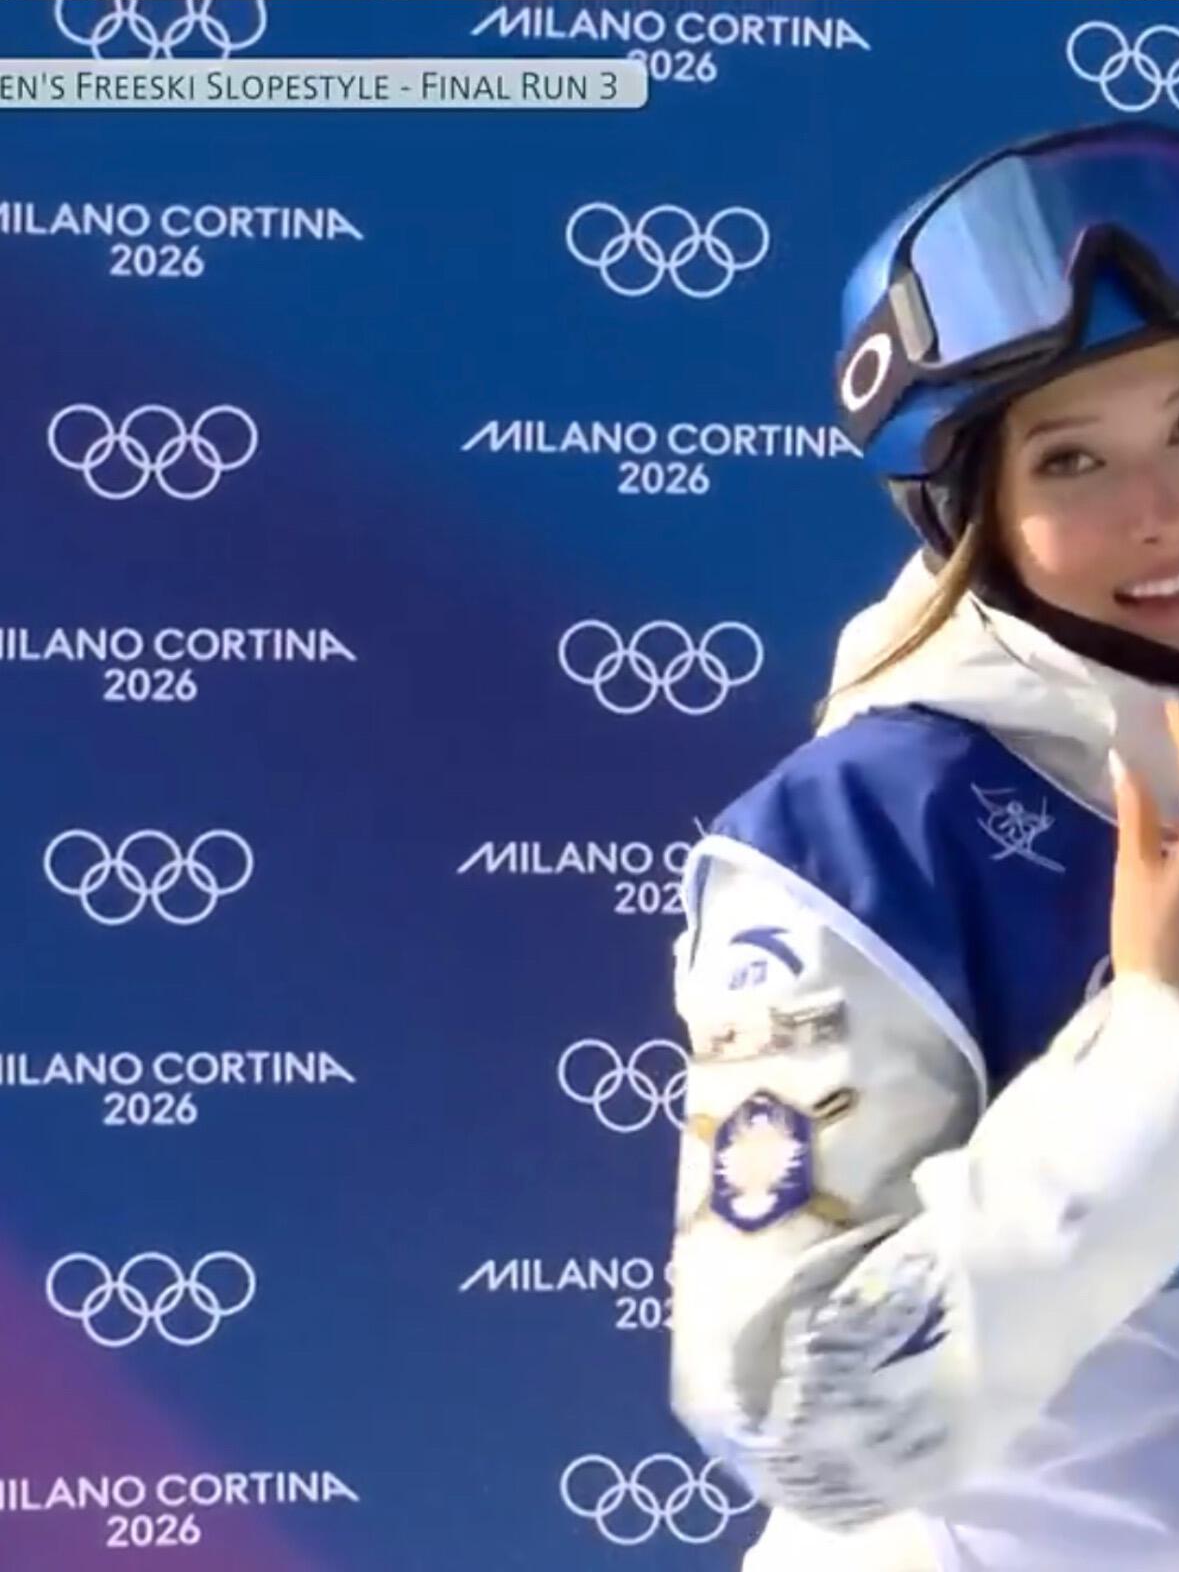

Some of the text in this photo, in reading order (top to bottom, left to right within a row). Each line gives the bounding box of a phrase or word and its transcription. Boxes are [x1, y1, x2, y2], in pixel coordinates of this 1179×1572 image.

[471, 5, 870, 50] MILANO CORTINA
[0, 201, 364, 240] ILANO CORTINA
[109, 242, 205, 278] 2026
[461, 420, 864, 458] MILANO CORTINA
[618, 460, 710, 495] 2026
[0, 627, 357, 662] ILANO CORTINA
[103, 668, 198, 702] 2026
[457, 841, 654, 875] MILANO
[614, 881, 683, 914] 202
[0, 1051, 356, 1086] ILANO CORTINA
[103, 1091, 198, 1126] 2026
[459, 1257, 654, 1291] MILANO
[0, 1471, 359, 1511] ILANO CORTINA
[106, 1513, 201, 1548] 2026
